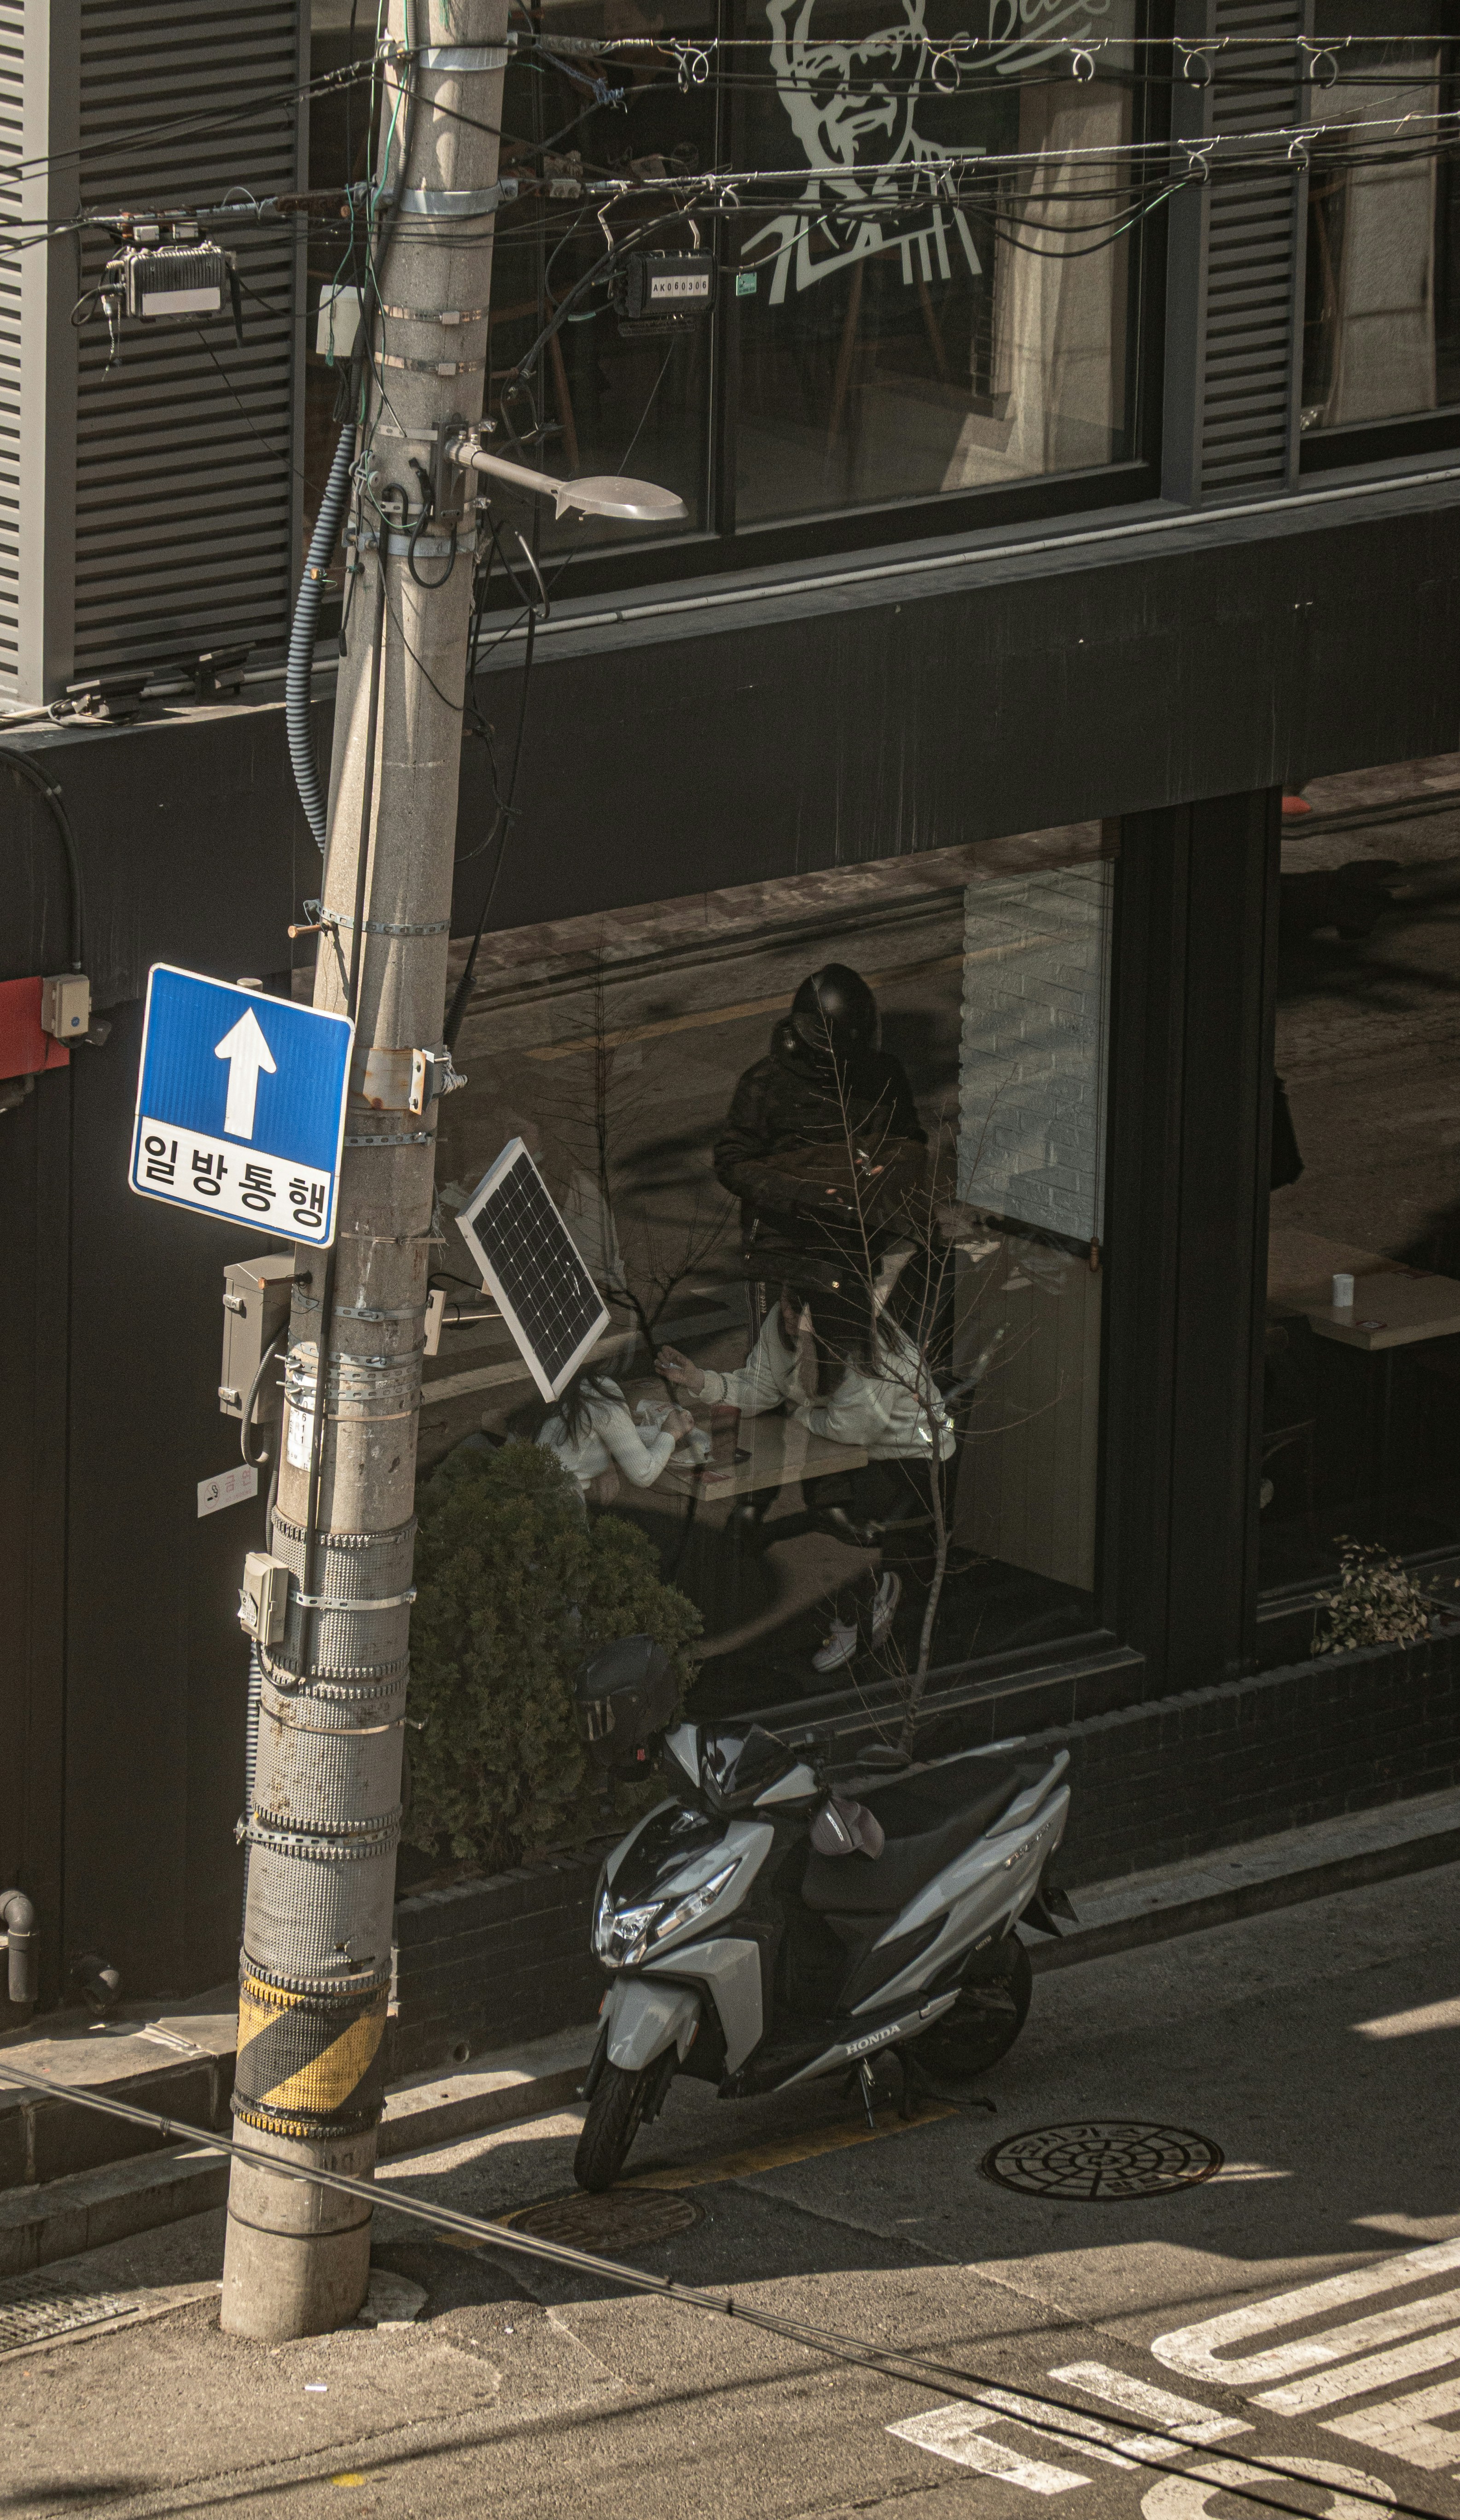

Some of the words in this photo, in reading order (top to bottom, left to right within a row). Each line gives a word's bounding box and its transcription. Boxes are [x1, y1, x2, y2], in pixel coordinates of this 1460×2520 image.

[653, 280, 707, 292] AK060306
[145, 1136, 325, 1228] 일방통행
[846, 2024, 901, 2055] HONDA
[1008, 2127, 1142, 2157] 도시가스
